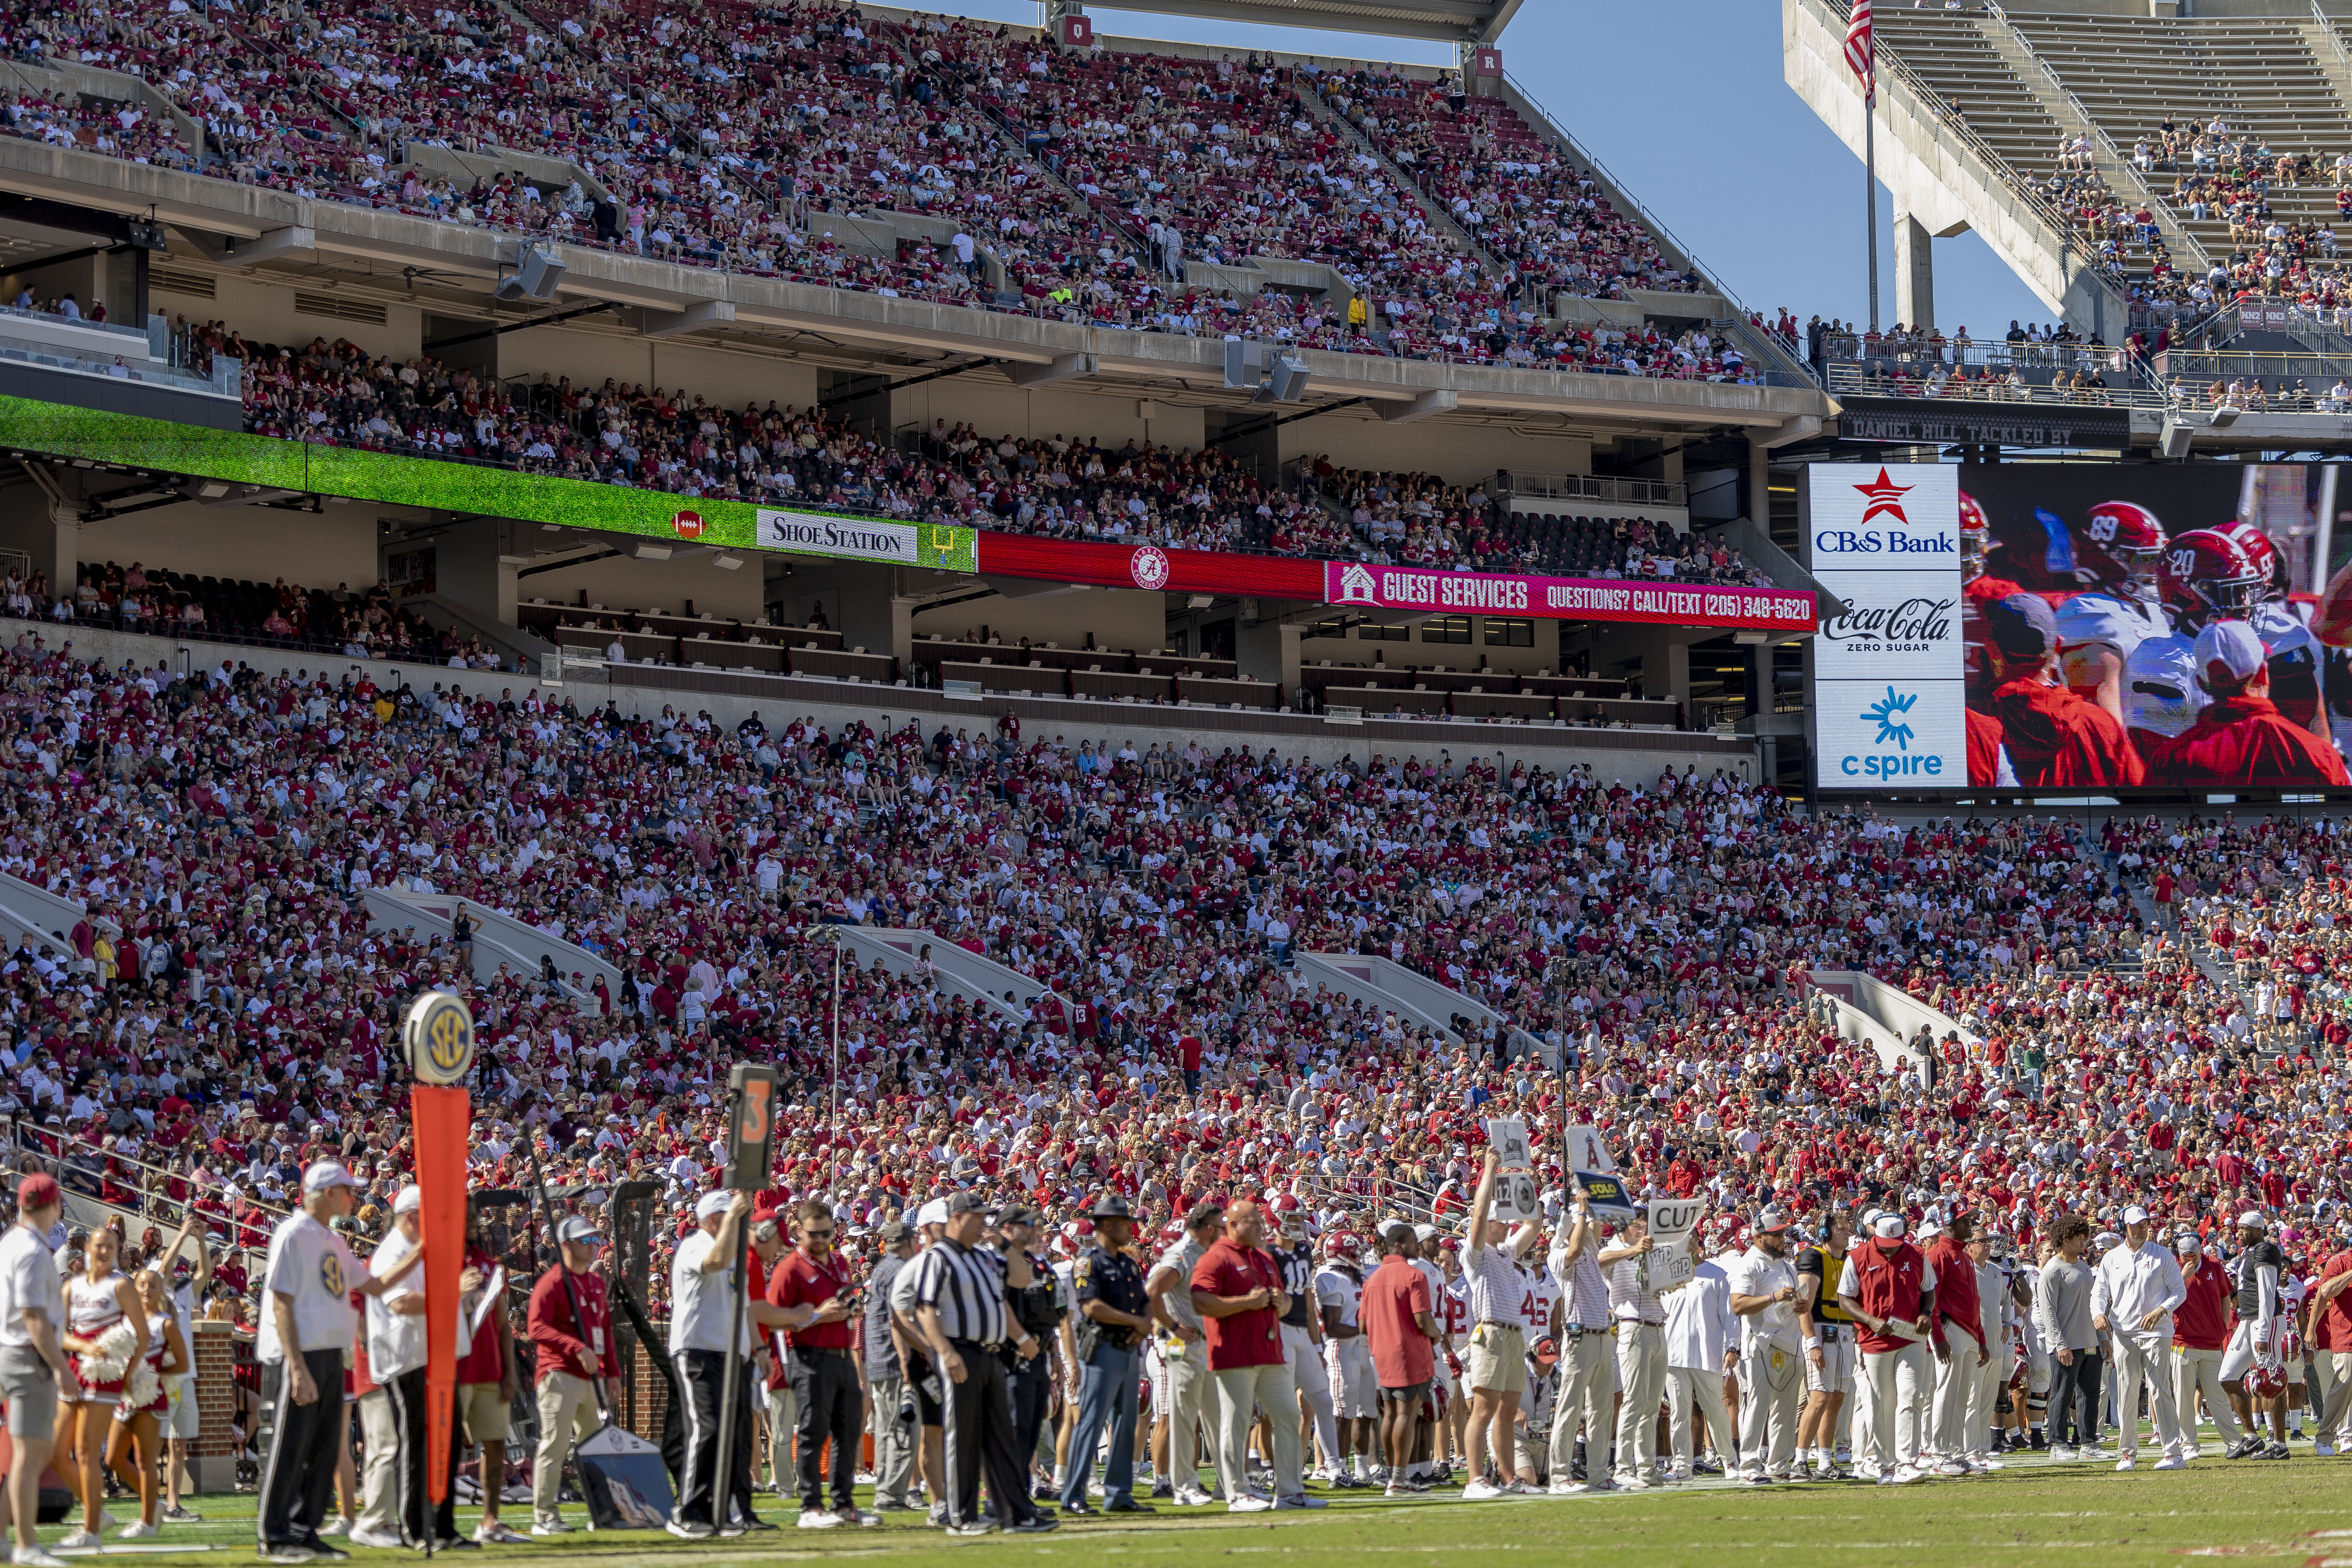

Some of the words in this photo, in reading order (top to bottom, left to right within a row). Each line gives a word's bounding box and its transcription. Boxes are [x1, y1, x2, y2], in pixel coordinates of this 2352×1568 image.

[1485, 56, 1494, 69] R
[2241, 311, 2261, 320] NN2
[2266, 312, 2284, 320] NN3
[1854, 420, 1915, 438] DANIEL
[1922, 422, 1960, 440] HILL
[1969, 423, 2043, 443] TACKLED
[2051, 427, 2072, 445] BY
[2089, 515, 2119, 541] 89
[1816, 531, 1882, 553] CB&S
[1888, 531, 1955, 552] Bank
[1142, 560, 1157, 576] A
[2171, 549, 2196, 576] 20
[1383, 572, 1437, 604] GUEST
[1441, 577, 1528, 610] SERVICES
[1547, 586, 1628, 612] QUESTIONS?
[1633, 590, 1700, 615] CALL/TEXT
[1705, 593, 1742, 617] (205)
[1743, 596, 1809, 621] 348-5620
[1823, 598, 1957, 642] Coca-Cola
[1071, 857, 1078, 867] 6
[1075, 1009, 1086, 1023] 13
[197, 1033, 204, 1042] 2
[430, 1010, 465, 1069] SEC
[742, 1080, 770, 1143] 3
[1125, 1185, 1132, 1198] 2
[1497, 1184, 1510, 1202] 12
[1589, 1183, 1617, 1195] SOLO
[1656, 1206, 1700, 1229] CUT
[1722, 1218, 1732, 1228] 81
[1886, 1227, 1895, 1236] A
[1900, 1261, 1910, 1271] A
[1284, 1259, 1310, 1295] 10
[1546, 1344, 1555, 1353] A
